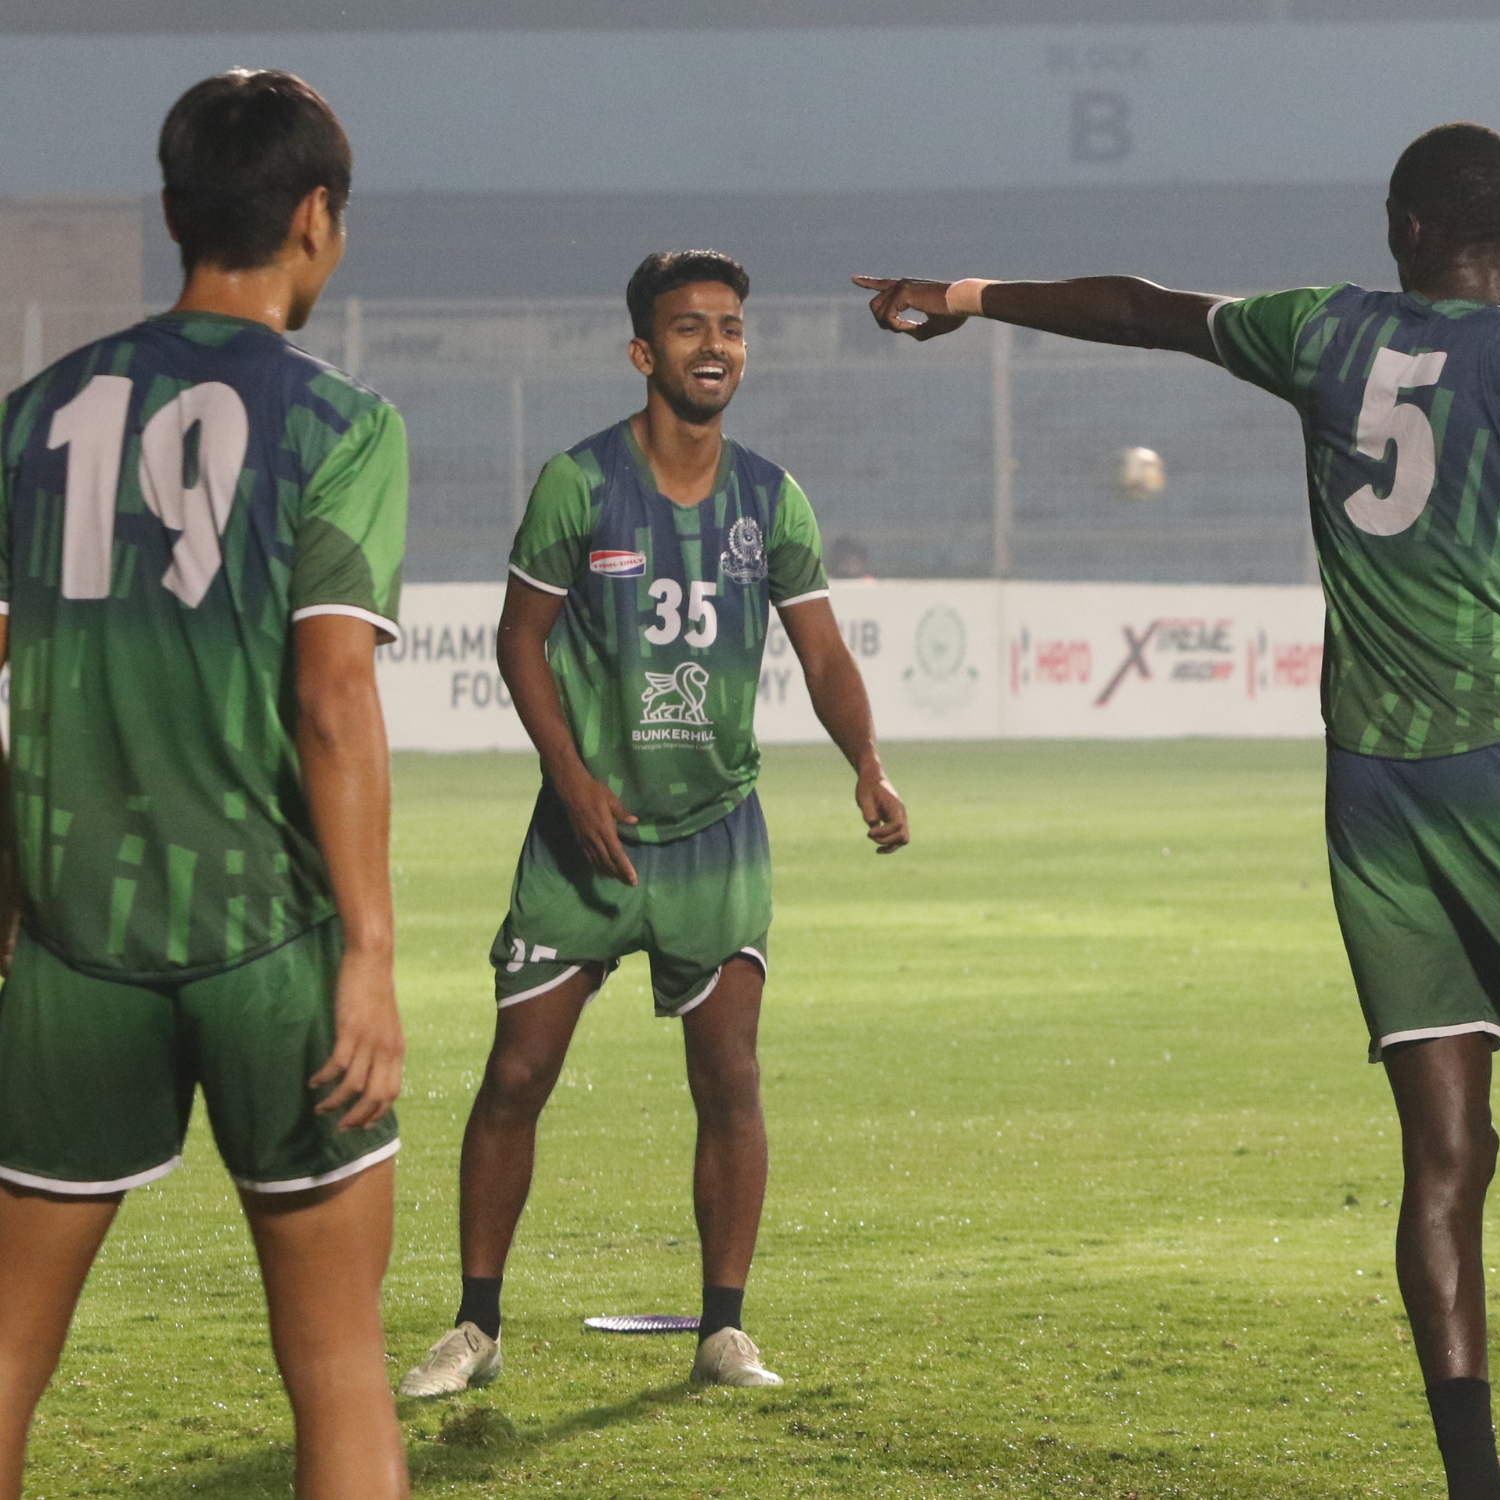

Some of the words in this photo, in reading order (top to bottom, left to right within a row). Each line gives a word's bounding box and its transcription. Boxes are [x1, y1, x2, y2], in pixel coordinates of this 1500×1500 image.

[1069, 91, 1131, 162] B
[1343, 346, 1448, 536] 5
[47, 375, 249, 609] 19
[376, 624, 499, 663] OHAM
[644, 578, 717, 648] 35
[632, 728, 716, 742] BUNKERHILL
